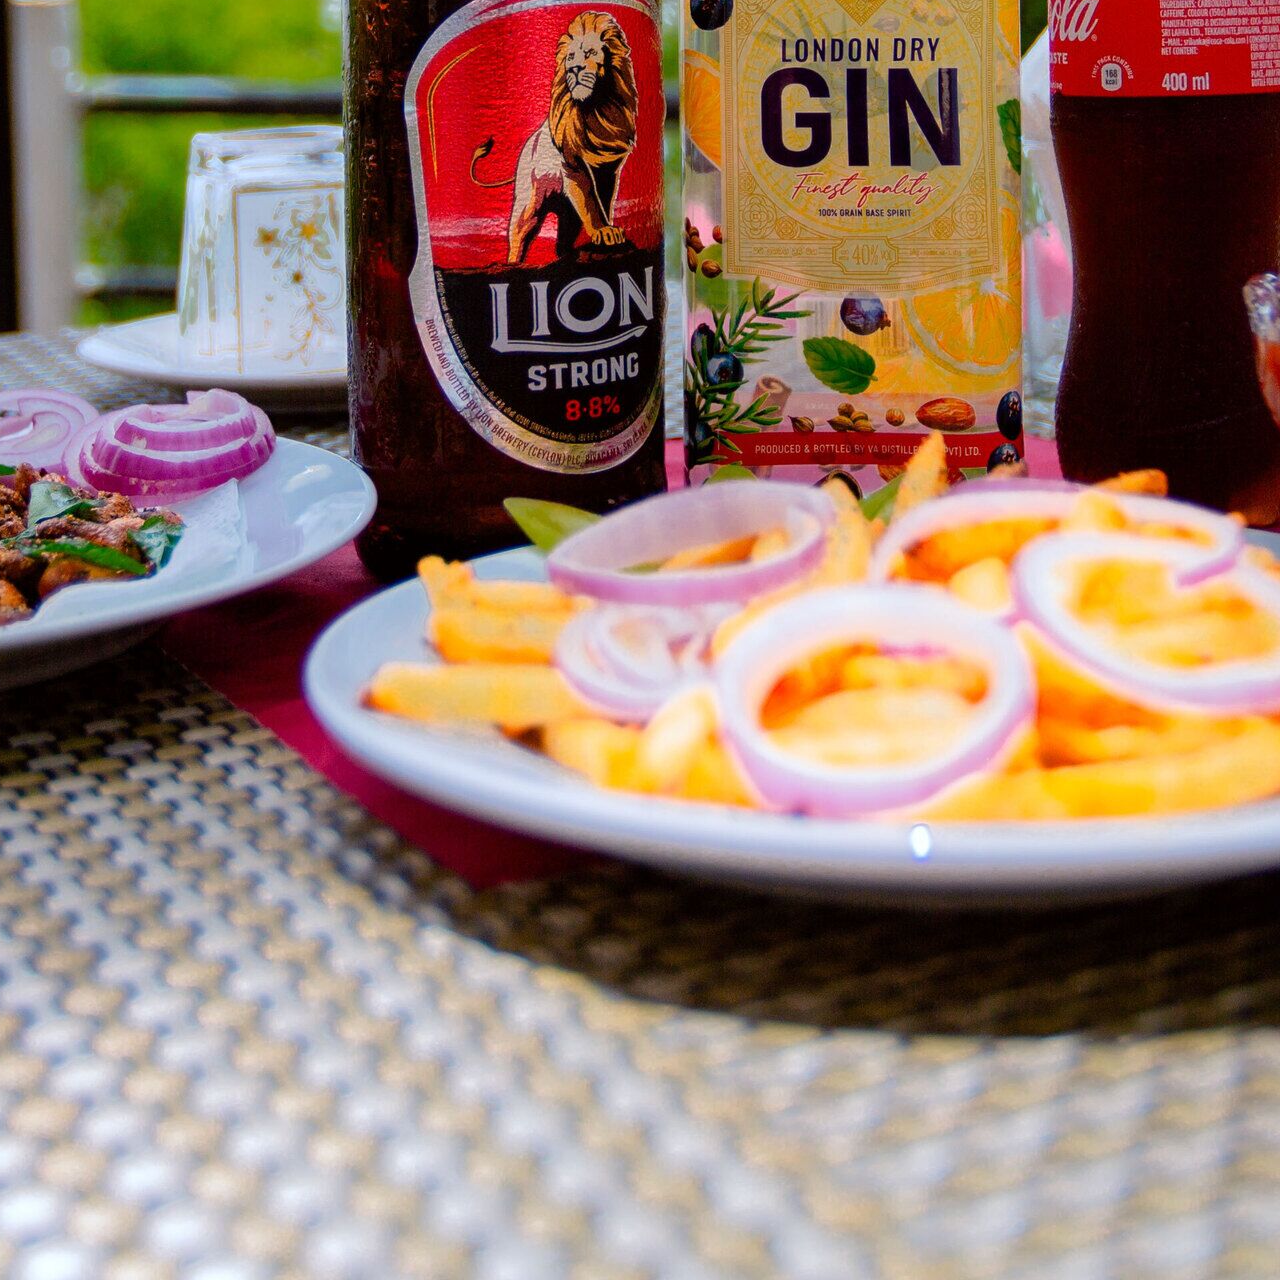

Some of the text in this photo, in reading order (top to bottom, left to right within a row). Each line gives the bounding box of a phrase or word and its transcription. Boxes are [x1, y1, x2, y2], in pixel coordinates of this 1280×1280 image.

[781, 37, 940, 63] LONDON DRY
[1105, 69, 1118, 78] 168
[1161, 72, 1210, 91] 400 ml
[761, 67, 962, 168] GIN
[790, 172, 942, 208] Finest quality
[818, 208, 911, 217] 100% GRAIN BASE SPIRIT
[489, 266, 655, 353] LION
[527, 352, 640, 392] STRONG
[425, 318, 443, 352] BREWED
[436, 352, 451, 370] AND
[445, 368, 471, 402] BOTTLED
[466, 399, 479, 412] BY
[475, 408, 494, 428] LION
[491, 423, 529, 453] BREWERY
[528, 442, 566, 466] (CEYLON)
[755, 444, 801, 455] PRODUCED
[804, 444, 810, 454] &
[813, 444, 851, 455] BOTTLED
[853, 444, 864, 454] BY
[867, 444, 879, 454] VA
[943, 446, 962, 457] PVT)
[964, 446, 982, 456] LTD.
